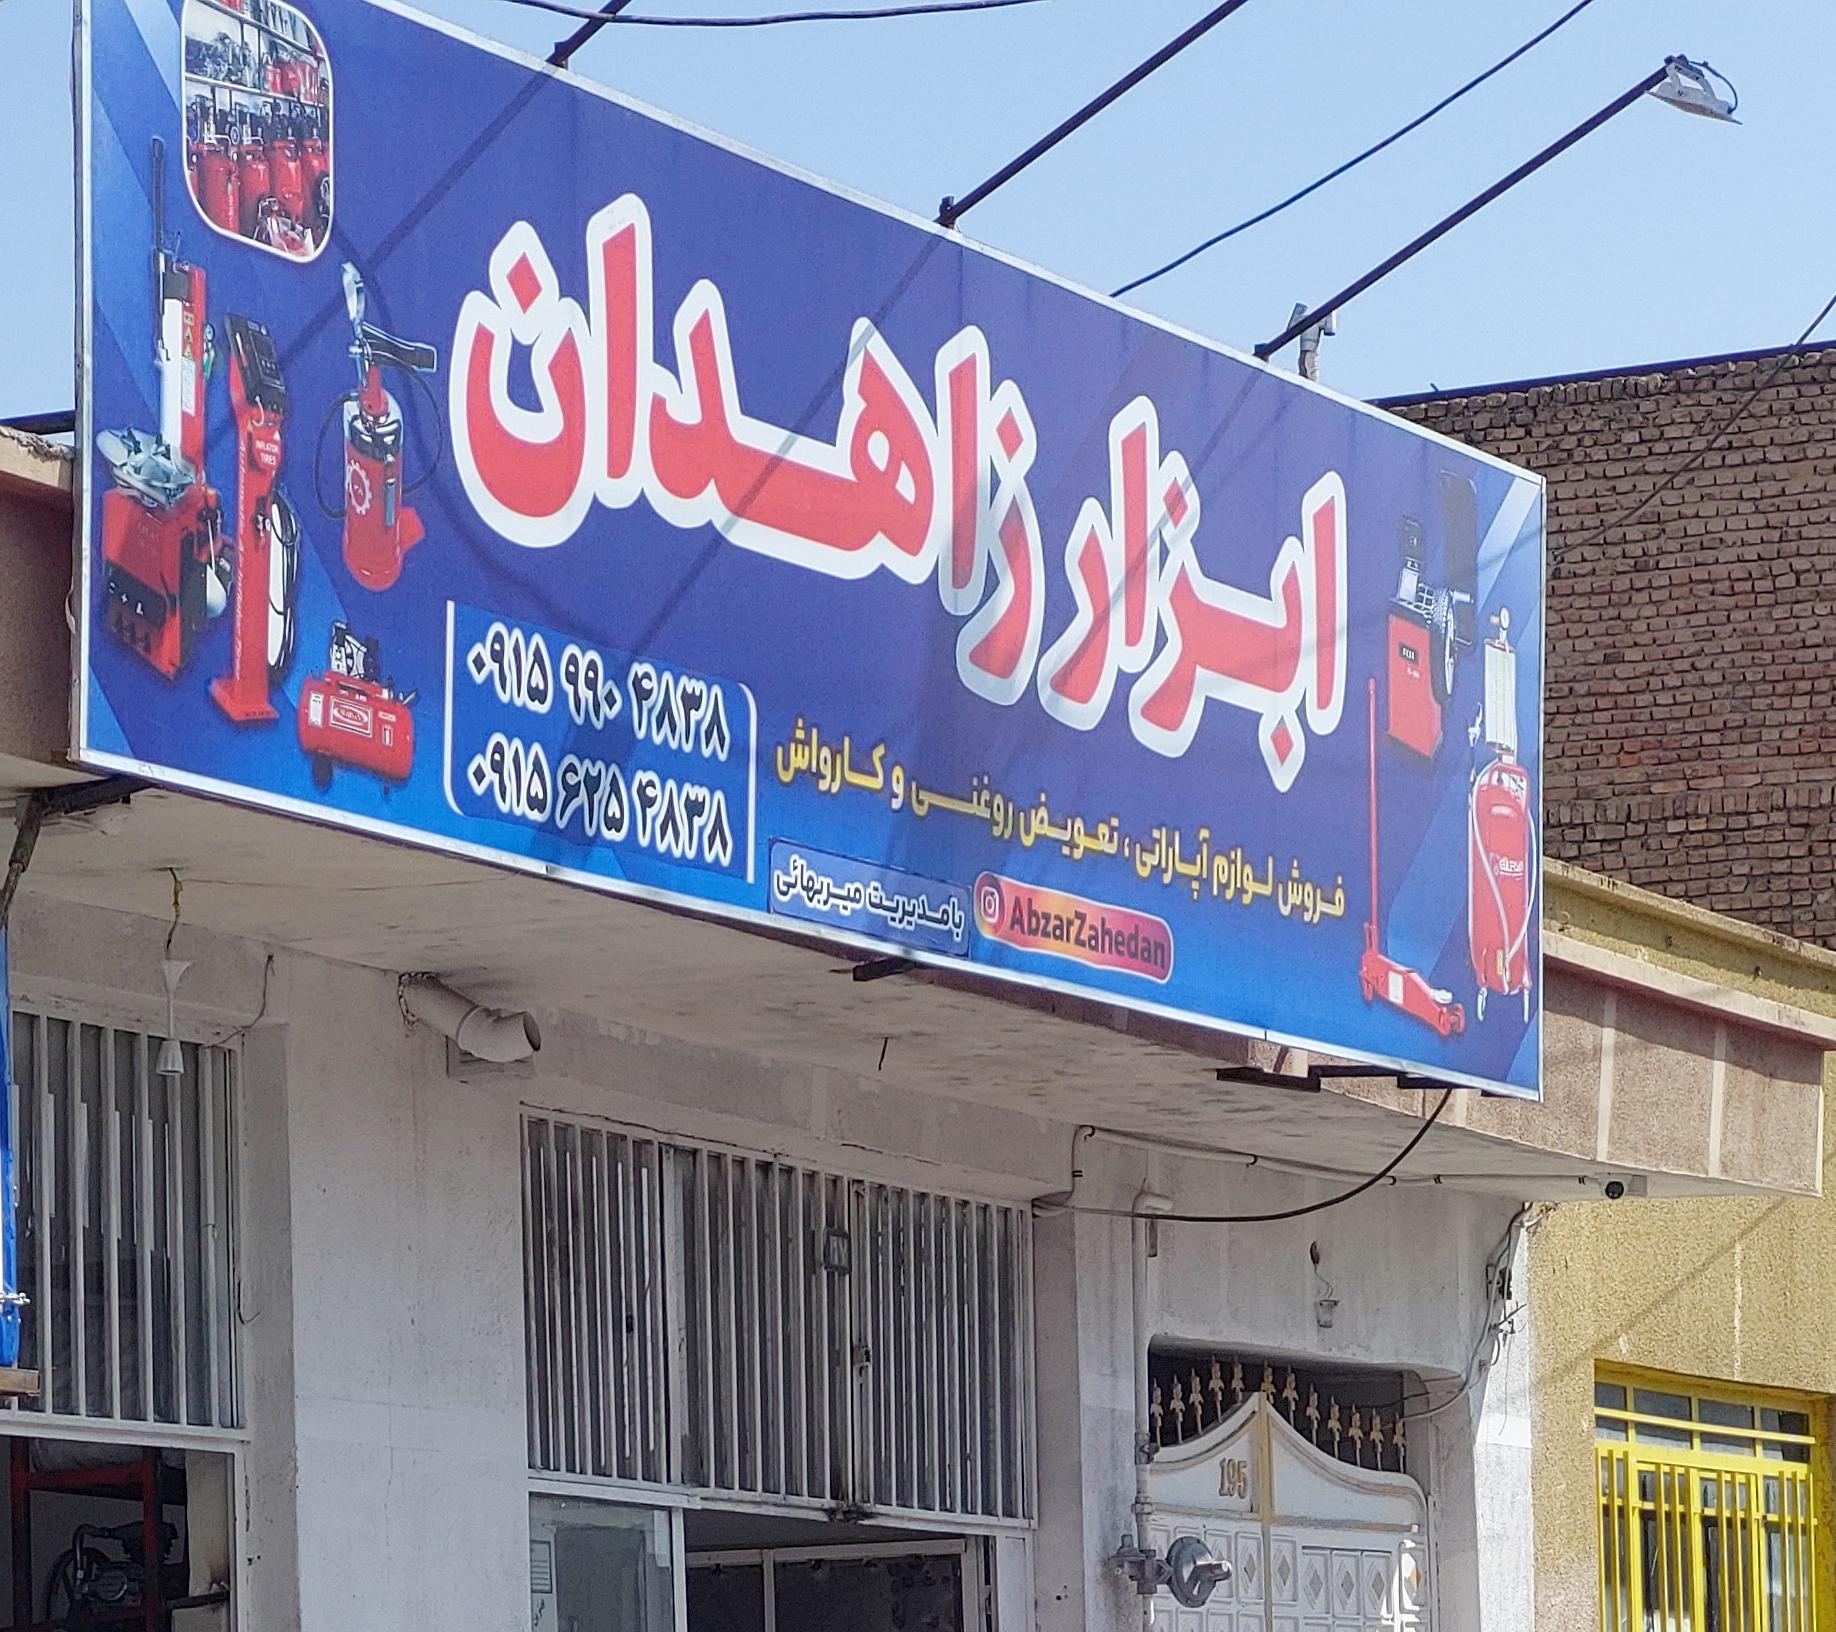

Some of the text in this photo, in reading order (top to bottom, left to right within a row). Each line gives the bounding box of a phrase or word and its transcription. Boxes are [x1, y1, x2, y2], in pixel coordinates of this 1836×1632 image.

[450, 193, 1348, 792] ابزار زاهدان
[467, 622, 730, 761] ۰۹۱۵ ۹۹۰ ۴۸۳۸
[776, 717, 887, 794] کارواش
[889, 764, 905, 811] و
[467, 732, 732, 867] ۰۹۱۵ ۶۲۵ ۴۸۳۸
[910, 774, 1014, 840] روغنی
[1018, 792, 1120, 860] تعویض
[1211, 847, 1274, 904] لوازم
[1278, 858, 1345, 923] فروش
[1009, 895, 1166, 970] AbzarZahedan
[1218, 1457, 1248, 1499] 195
